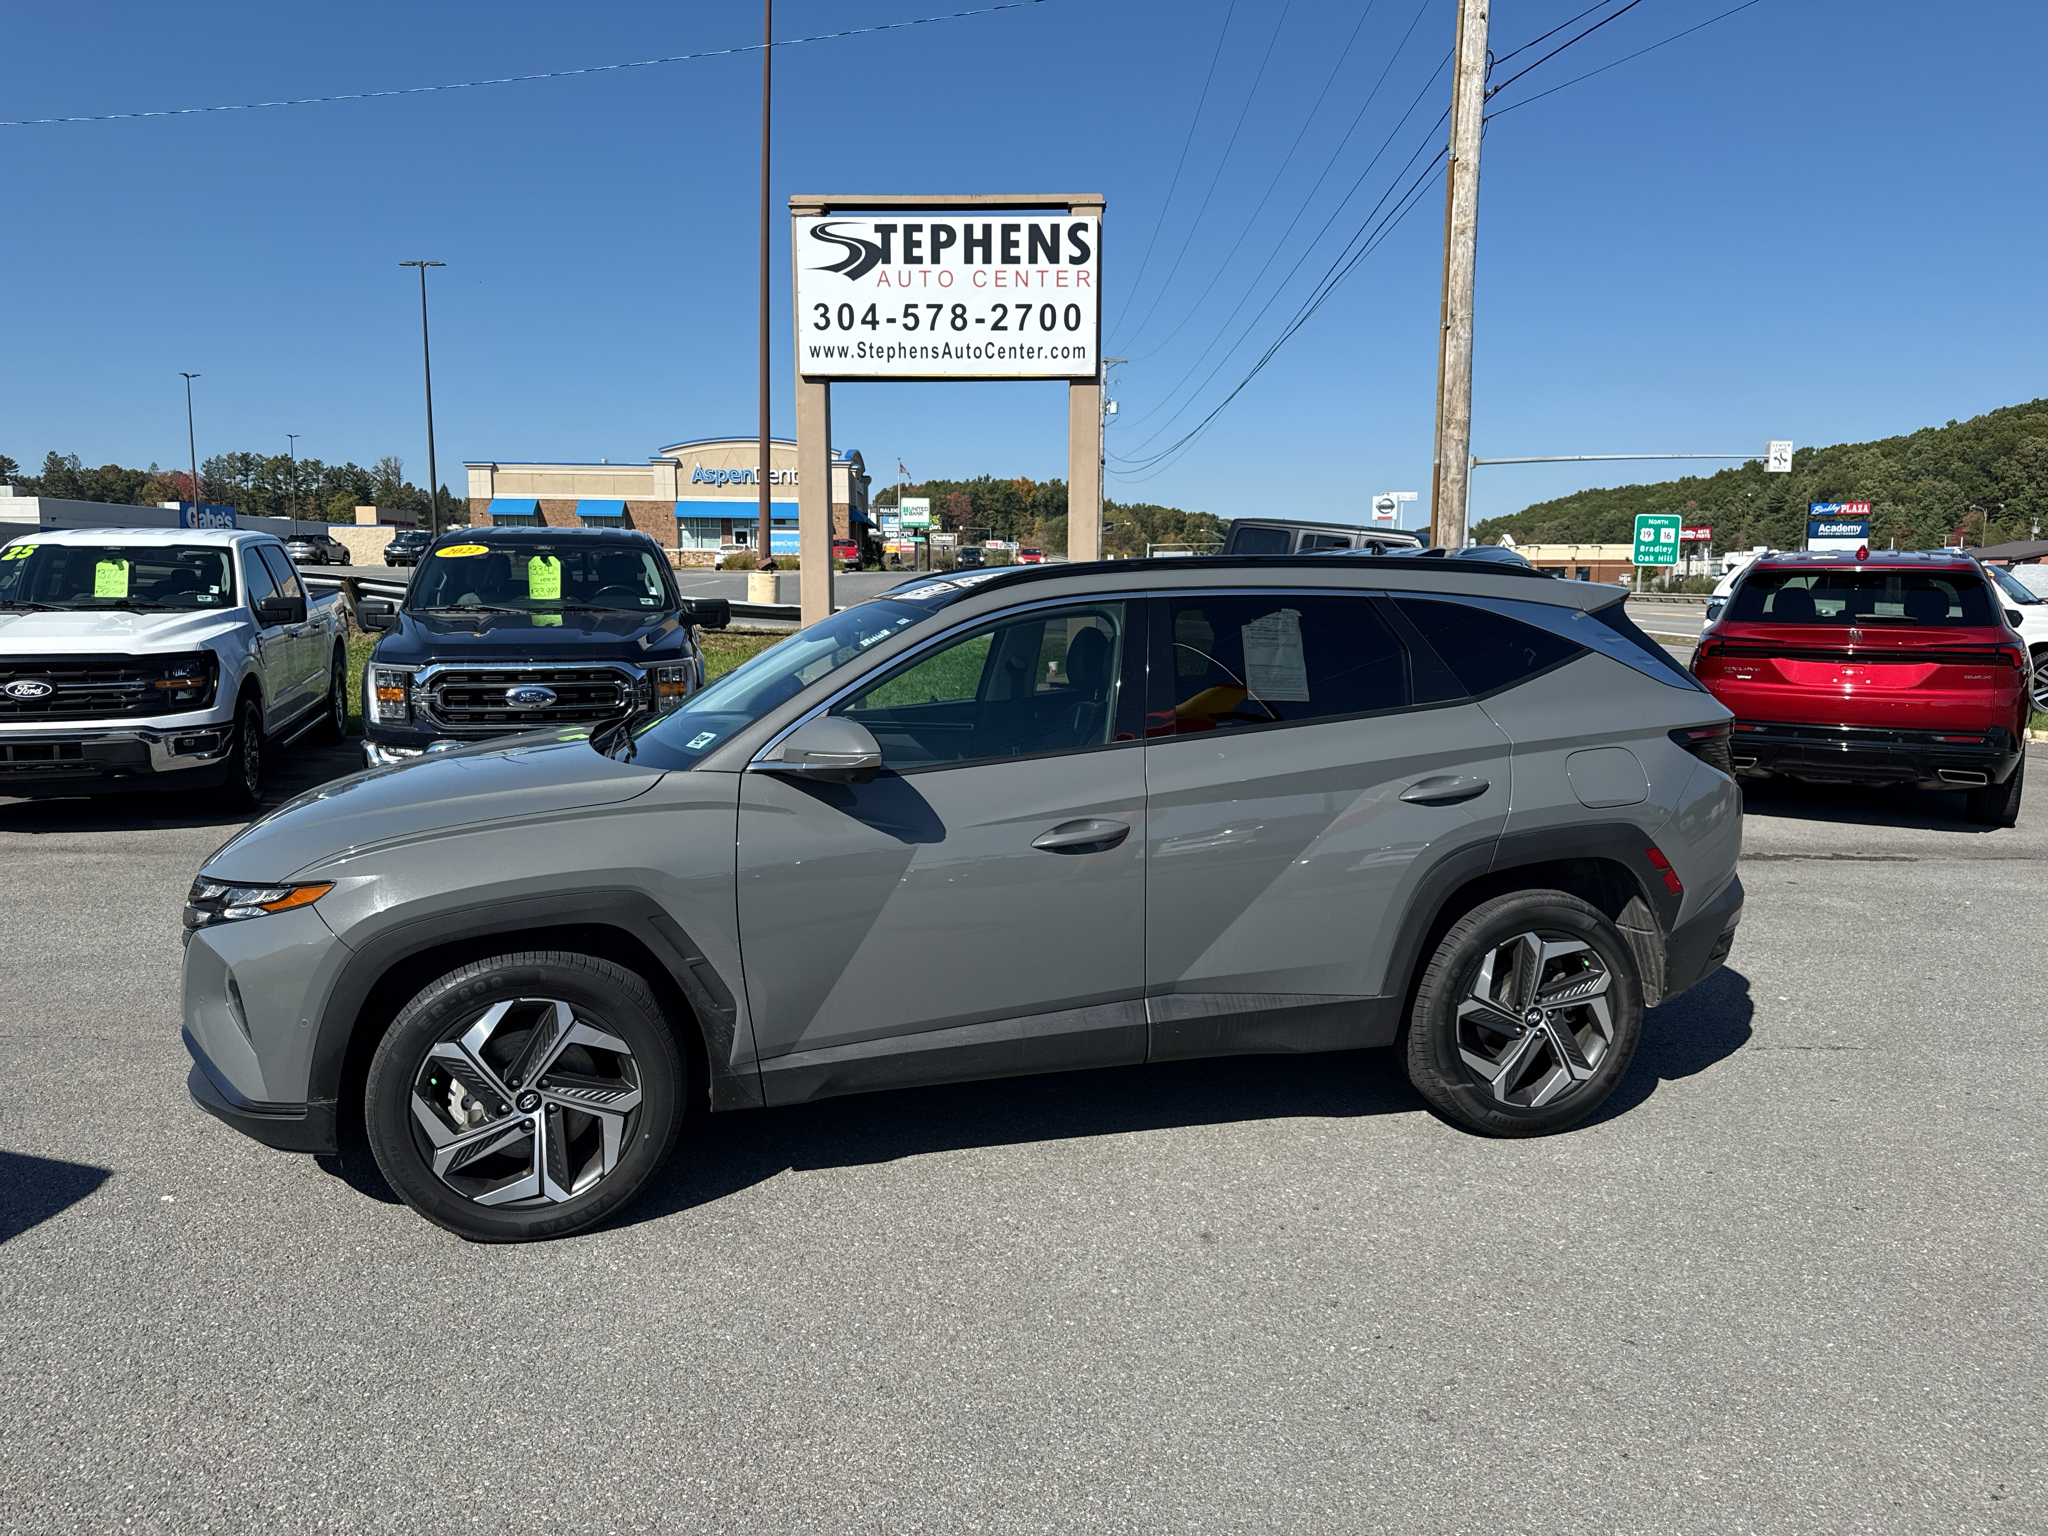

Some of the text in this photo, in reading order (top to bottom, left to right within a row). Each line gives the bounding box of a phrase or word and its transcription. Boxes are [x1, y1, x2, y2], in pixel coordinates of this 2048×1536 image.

[804, 222, 1092, 281] STEPHENS
[876, 269, 1092, 288] AUTO CENTER
[812, 302, 1082, 332] 304-578-2700
[808, 340, 1087, 364] www.StephensAutoCenter.com
[1840, 504, 1869, 513] PLAZA
[1818, 523, 1862, 535] Academy
[1643, 530, 1672, 540] 19 16
[1, 544, 40, 560] 25
[444, 546, 481, 556] 2022
[1639, 545, 1673, 554] Bradley
[14, 684, 44, 695] Ford
[518, 692, 544, 702] Ford
